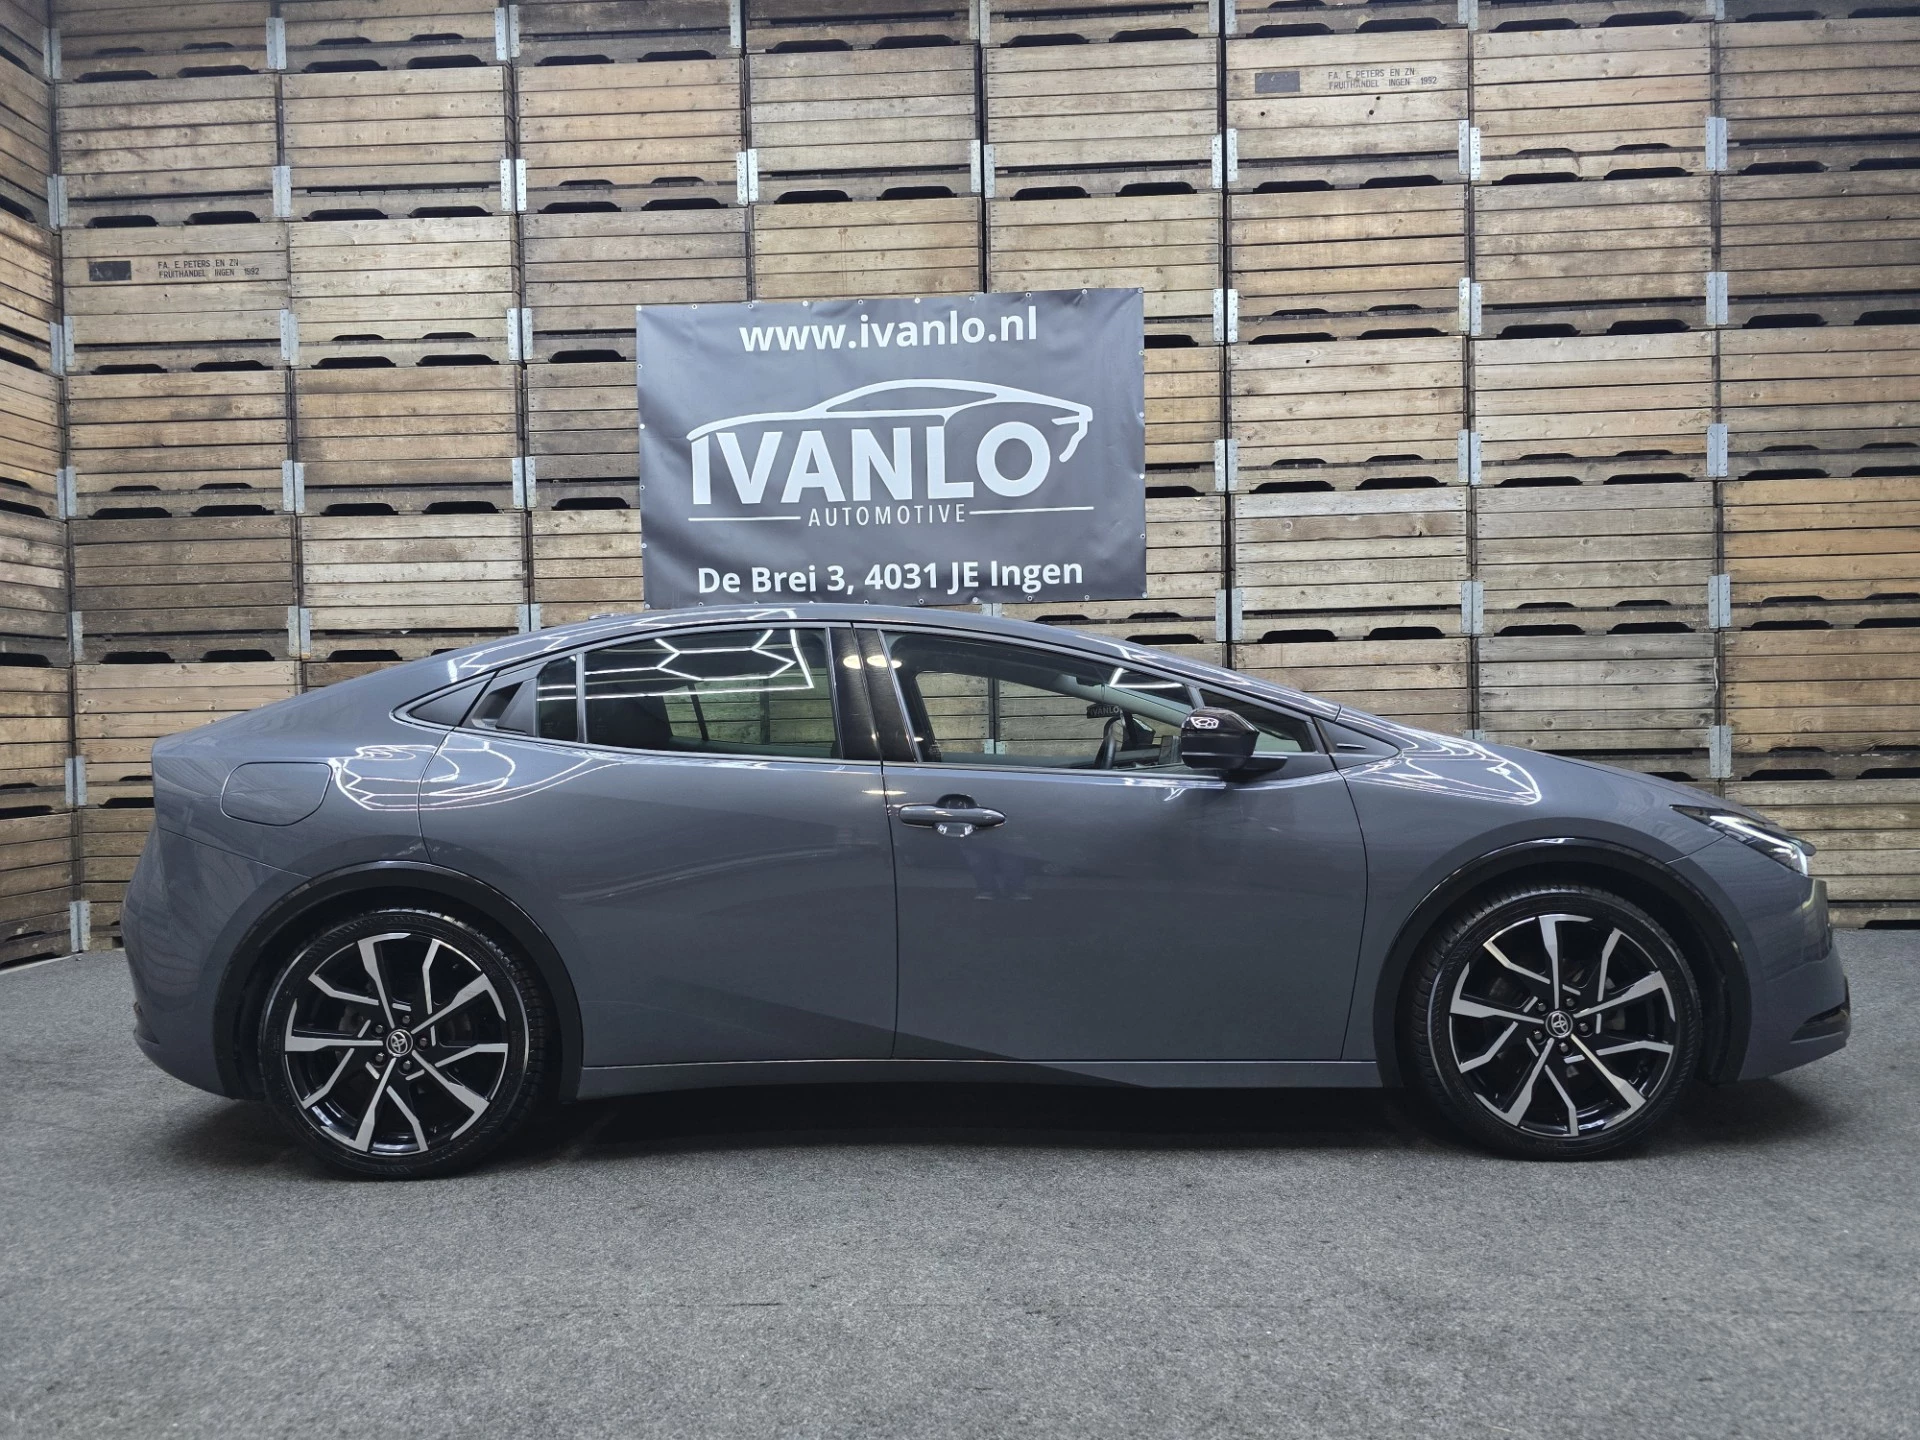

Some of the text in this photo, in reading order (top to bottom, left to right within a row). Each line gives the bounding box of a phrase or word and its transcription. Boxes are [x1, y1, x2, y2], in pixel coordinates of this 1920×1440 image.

[1356, 69, 1385, 79] PETERS
[1390, 68, 1400, 77] EN
[1405, 67, 1415, 76] ZN
[1328, 79, 1379, 90] FRUITHANDEL
[1388, 77, 1410, 87] INGEN
[183, 259, 211, 269] PETERS
[215, 259, 225, 267] EN
[229, 258, 239, 267] ZN
[158, 270, 206, 279] FRUITHANDEL
[214, 268, 235, 277] INGEN
[739, 305, 1038, 352] www.ivanlo.nl
[690, 420, 1051, 505] IVANLO
[808, 503, 966, 527] AUTOMOTIVE
[698, 560, 1083, 595] De Brei 3, 4031 JE Ingen
